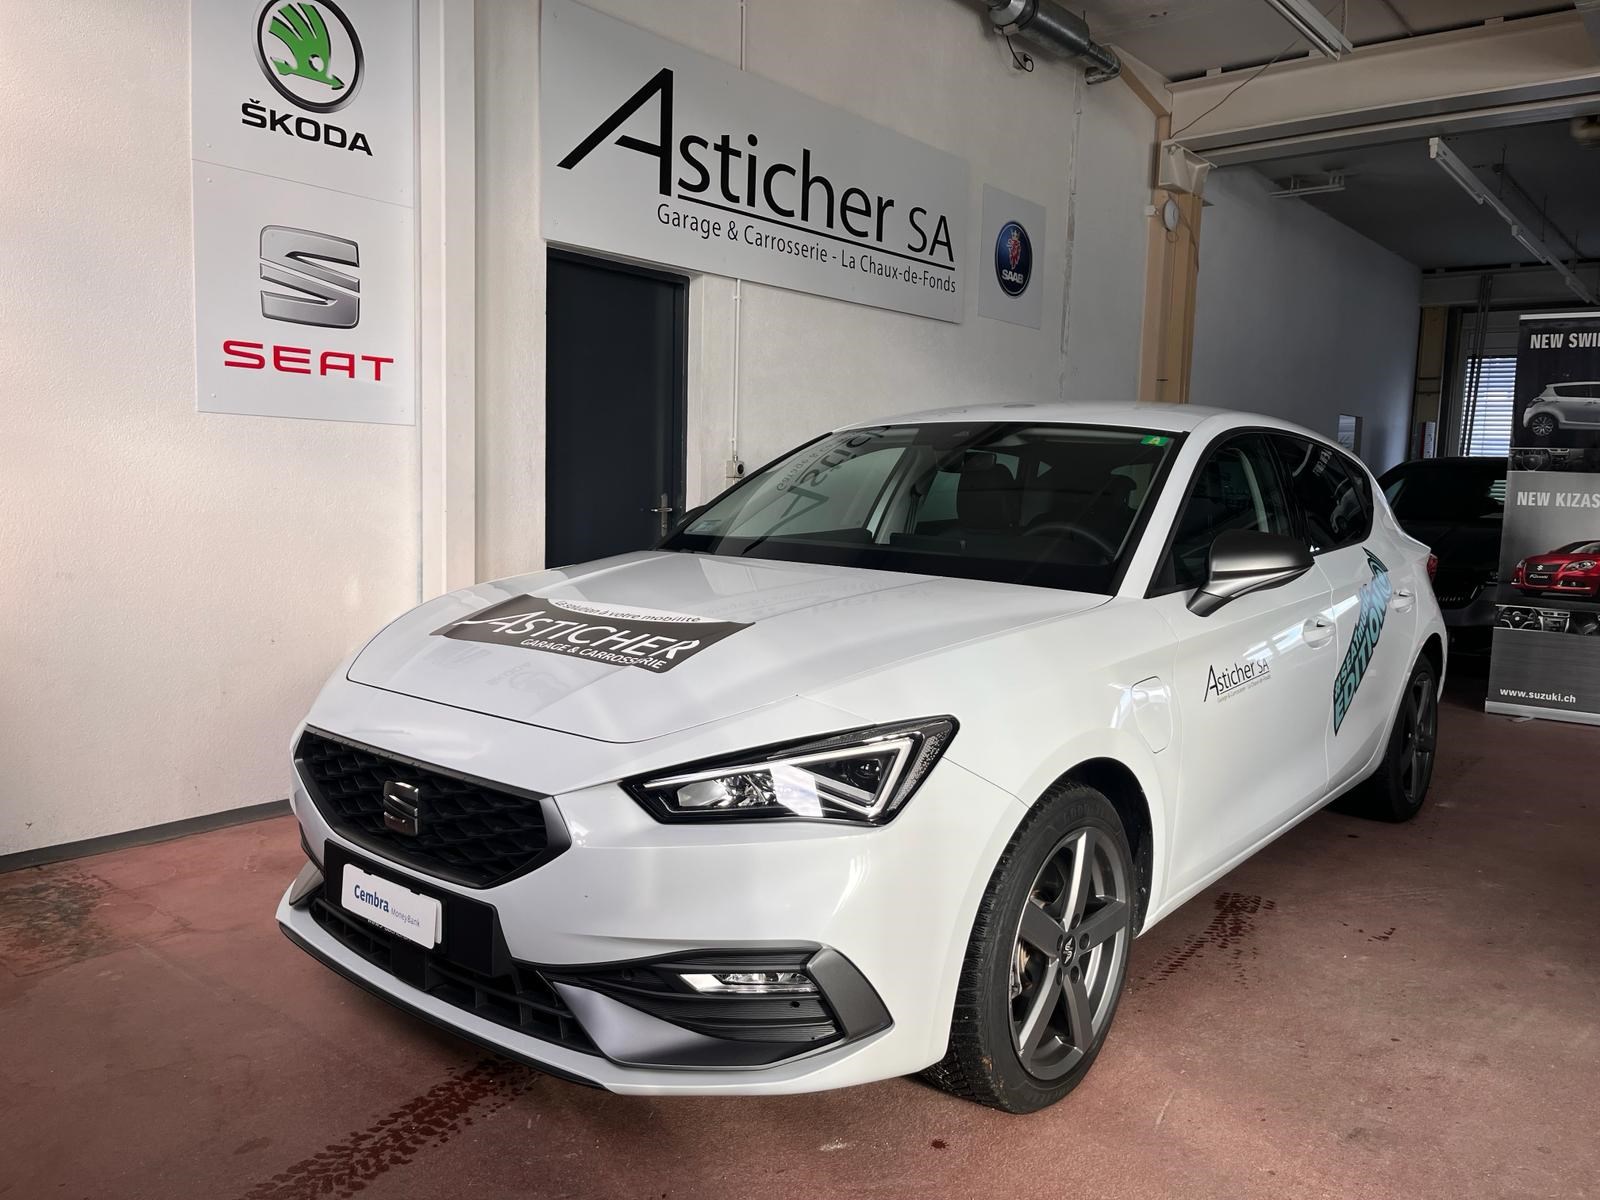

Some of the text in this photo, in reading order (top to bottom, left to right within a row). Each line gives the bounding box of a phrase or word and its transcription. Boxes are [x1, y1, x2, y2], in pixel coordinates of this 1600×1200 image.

[241, 98, 373, 156] ŠKODA
[557, 67, 954, 263] Asticher SA
[657, 203, 721, 239] Garage
[727, 220, 738, 241] &
[744, 225, 828, 262] Carrosserie
[842, 249, 855, 269] La
[860, 254, 956, 293] Chaux-de-Fonds
[1002, 269, 1024, 285] SAAB
[1530, 333, 1564, 349] NEW
[222, 339, 394, 381] SEAT
[1517, 491, 1600, 508] NEW KIZAS
[453, 611, 701, 660] ASTICHER
[520, 639, 568, 651] GARAGE
[568, 646, 579, 654] &
[1203, 661, 1255, 702] Asticher
[1499, 687, 1577, 704] www.suzuki.ch
[354, 884, 390, 913] Cembra
